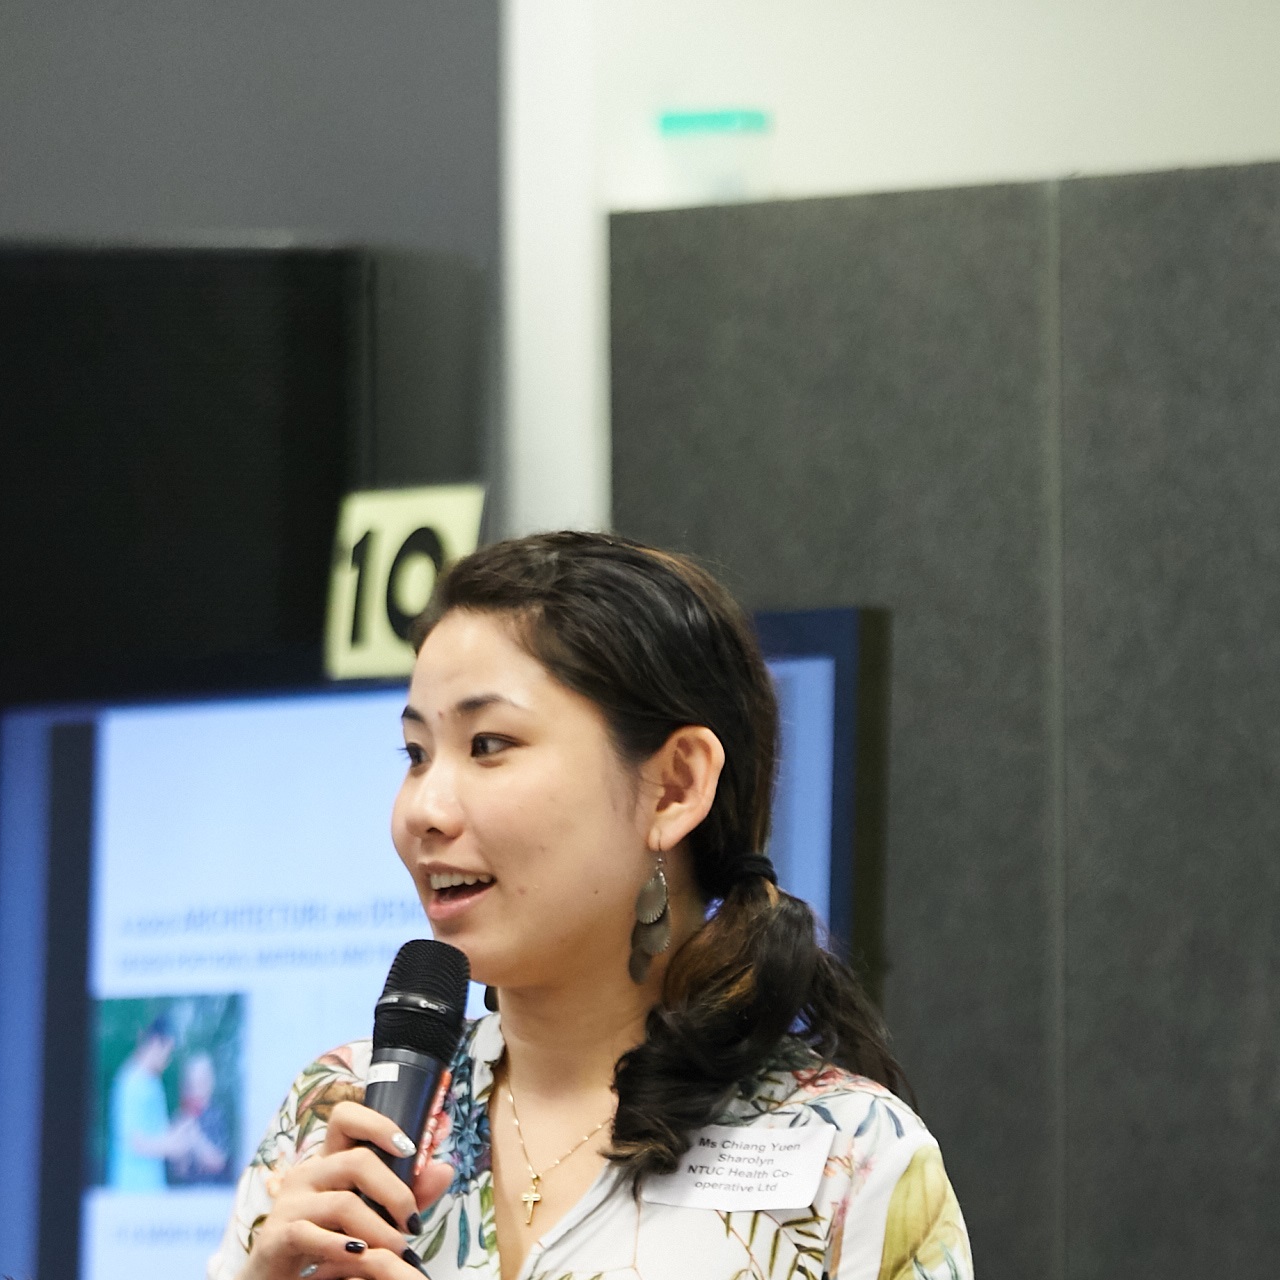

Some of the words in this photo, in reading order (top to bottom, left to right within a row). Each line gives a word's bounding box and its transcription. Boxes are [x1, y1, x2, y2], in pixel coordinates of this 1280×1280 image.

[350, 526, 444, 648] 10
[698, 1137, 717, 1149] Ms
[721, 1140, 766, 1153] Chiang
[772, 1142, 801, 1151] Yuen
[718, 1154, 774, 1166] Sharolyn
[687, 1165, 725, 1176] NTUC
[728, 1168, 768, 1179] Health
[773, 1169, 793, 1178] Co-
[695, 1180, 754, 1193] operative
[758, 1183, 778, 1192] Ltd
